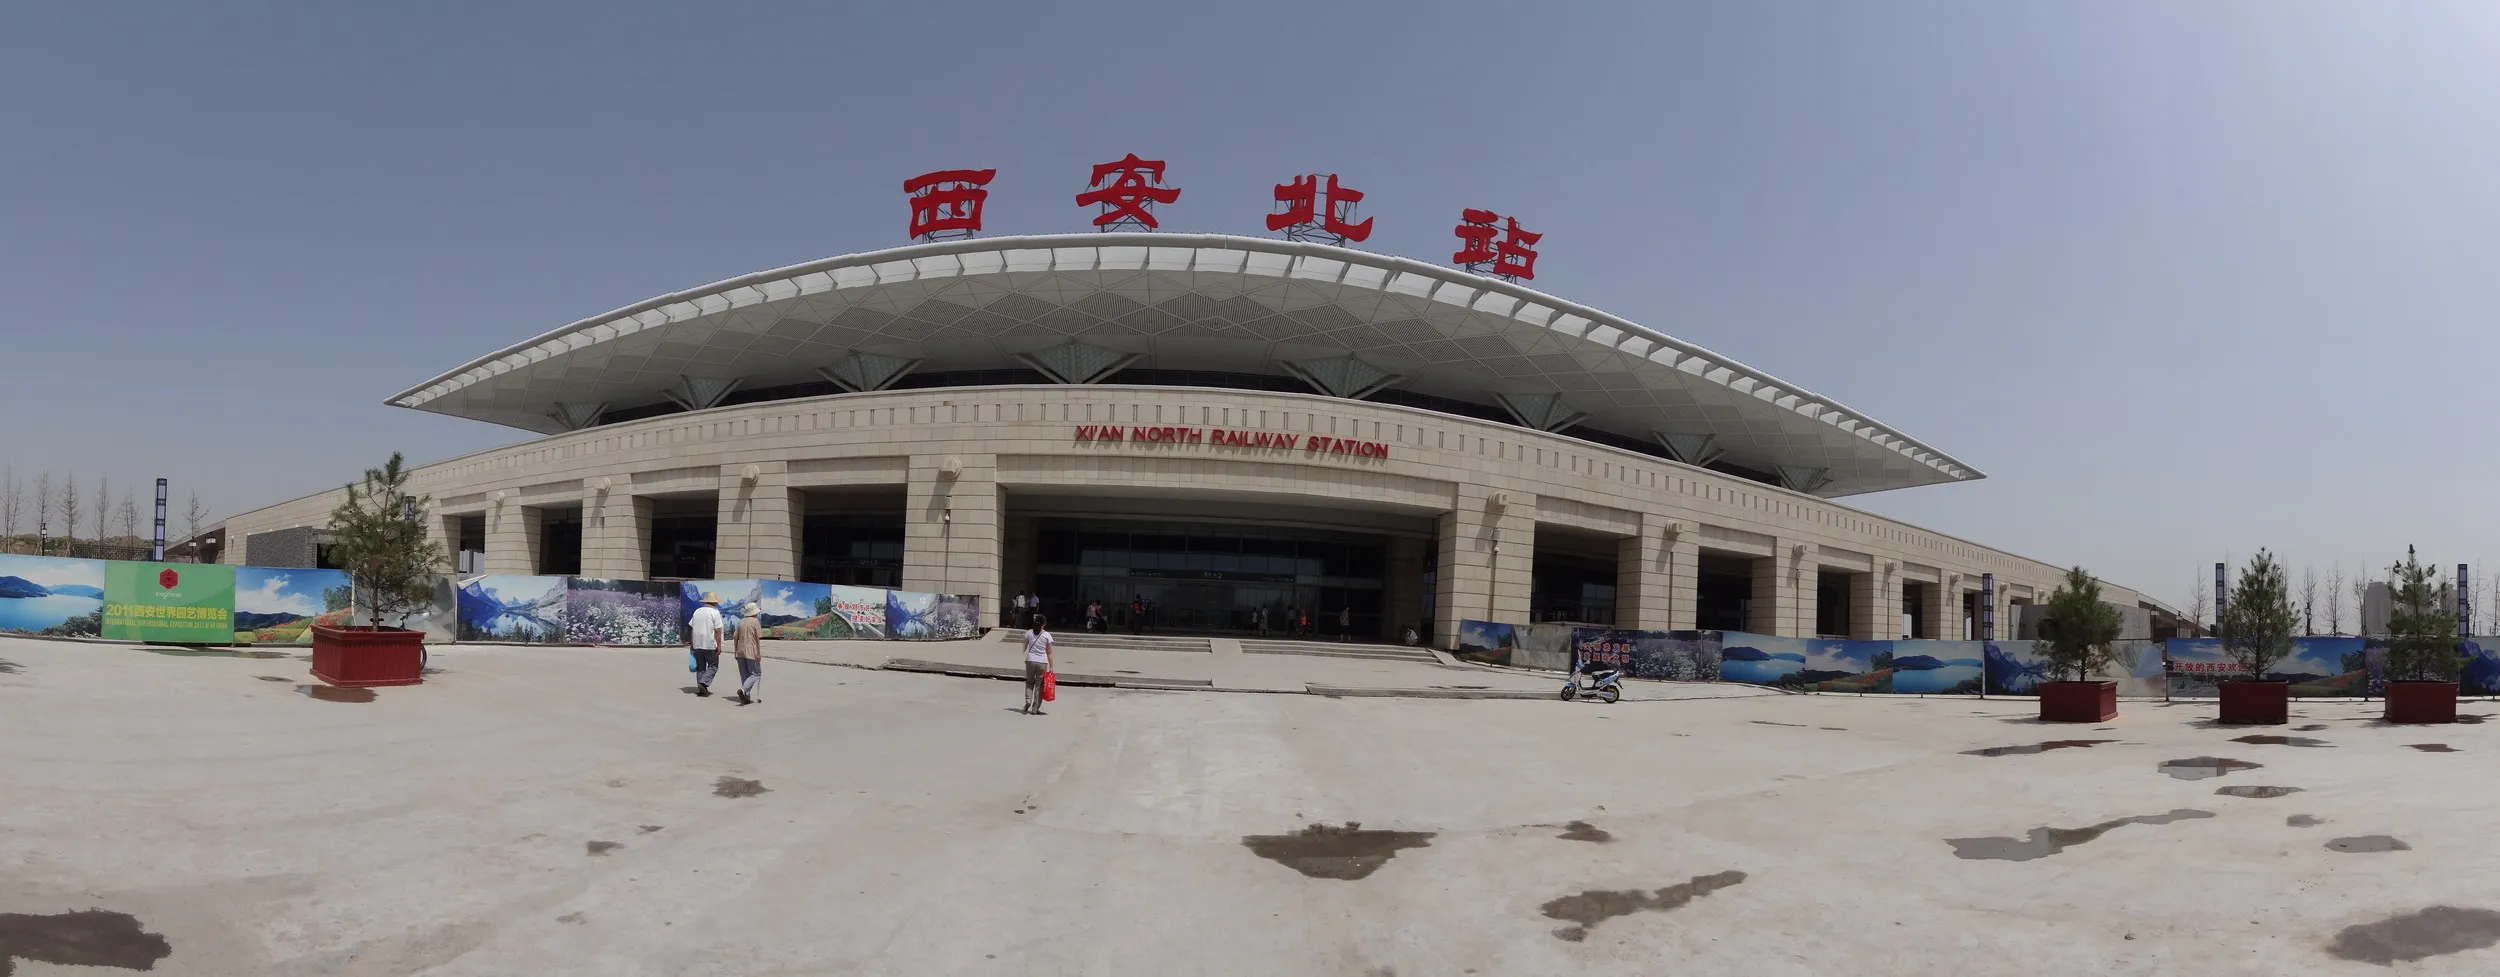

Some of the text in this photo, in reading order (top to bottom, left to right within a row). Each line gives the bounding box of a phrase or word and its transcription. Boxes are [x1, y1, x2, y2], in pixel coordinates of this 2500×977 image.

[904, 153, 1542, 280] 西安北站
[1076, 424, 1389, 459] XI'AN NORTH RAILWAY STATION
[106, 603, 228, 620] 2011西安世界园艺博览会
